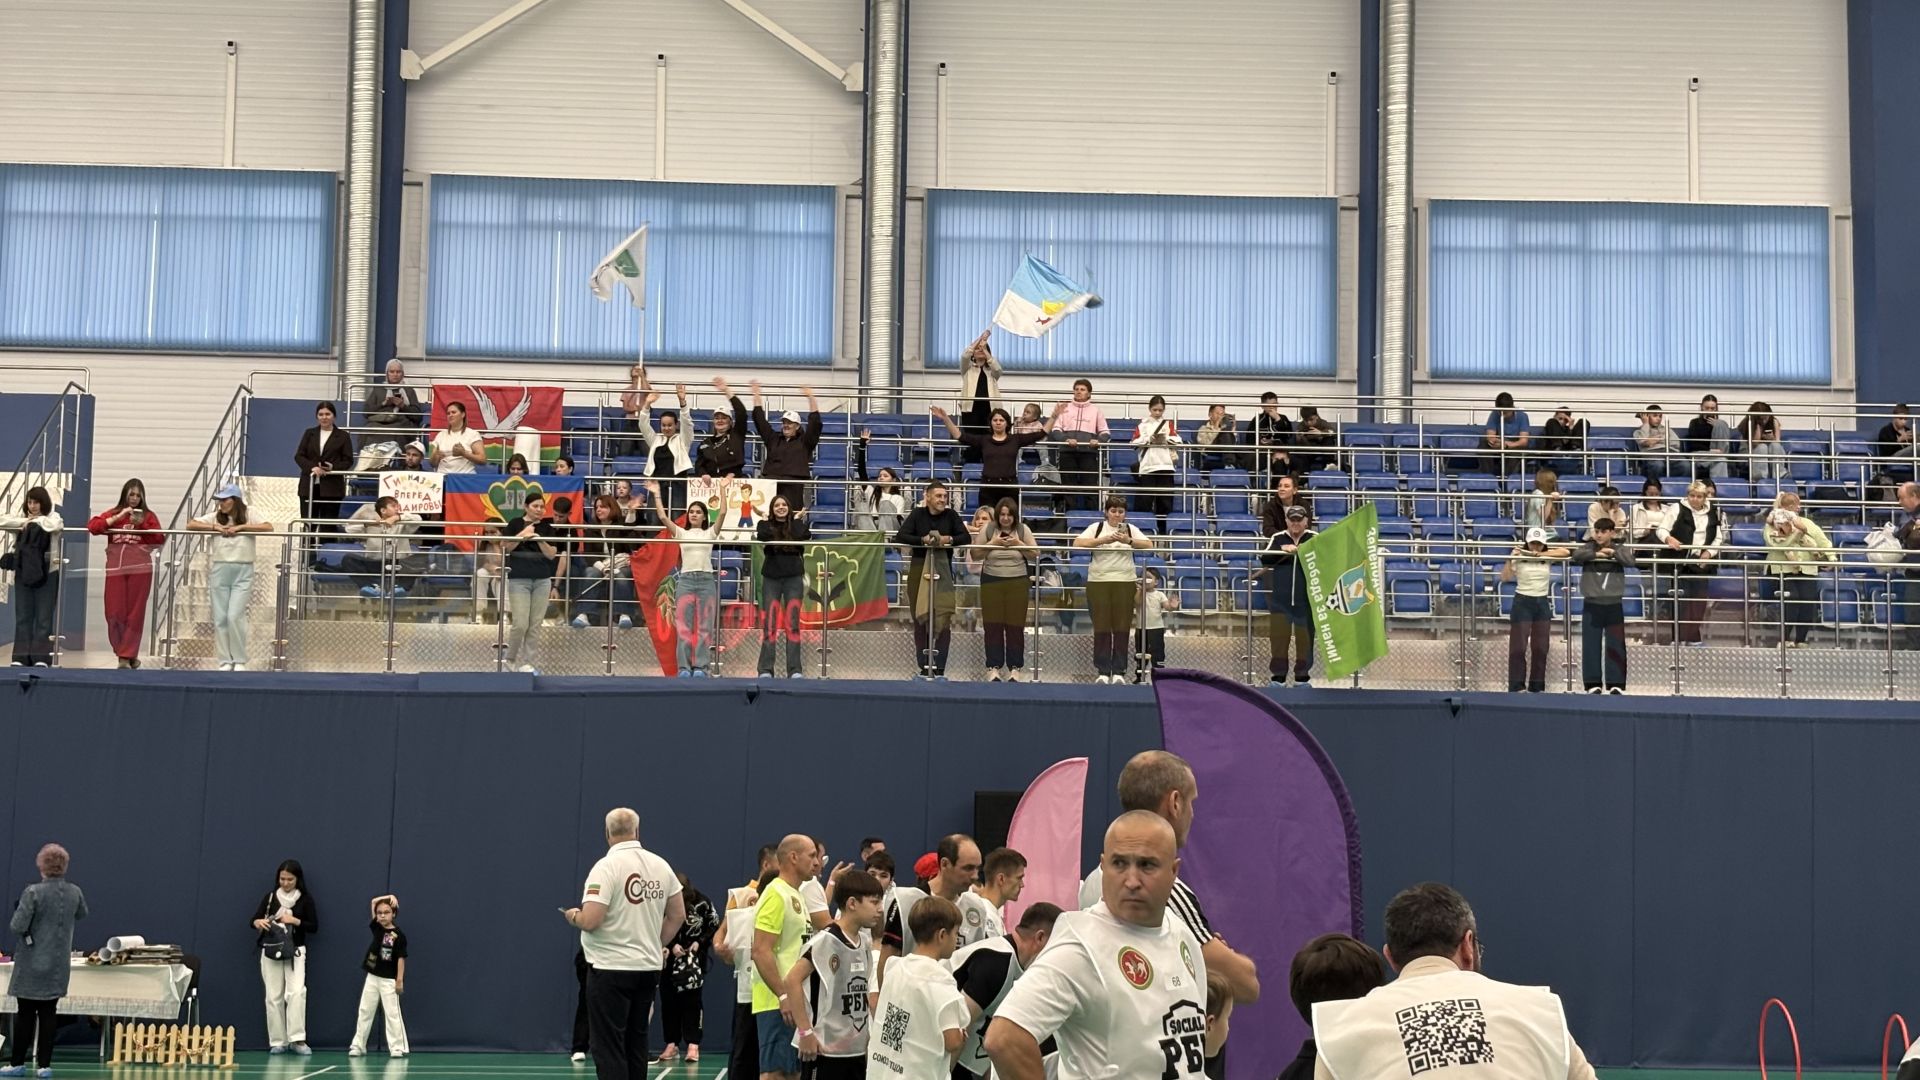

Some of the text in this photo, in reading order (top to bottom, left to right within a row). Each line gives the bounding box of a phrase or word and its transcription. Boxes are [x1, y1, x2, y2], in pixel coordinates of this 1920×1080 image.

[1304, 551, 1342, 664] Победа за нами!
[1169, 1016, 1205, 1035] SOCIAL
